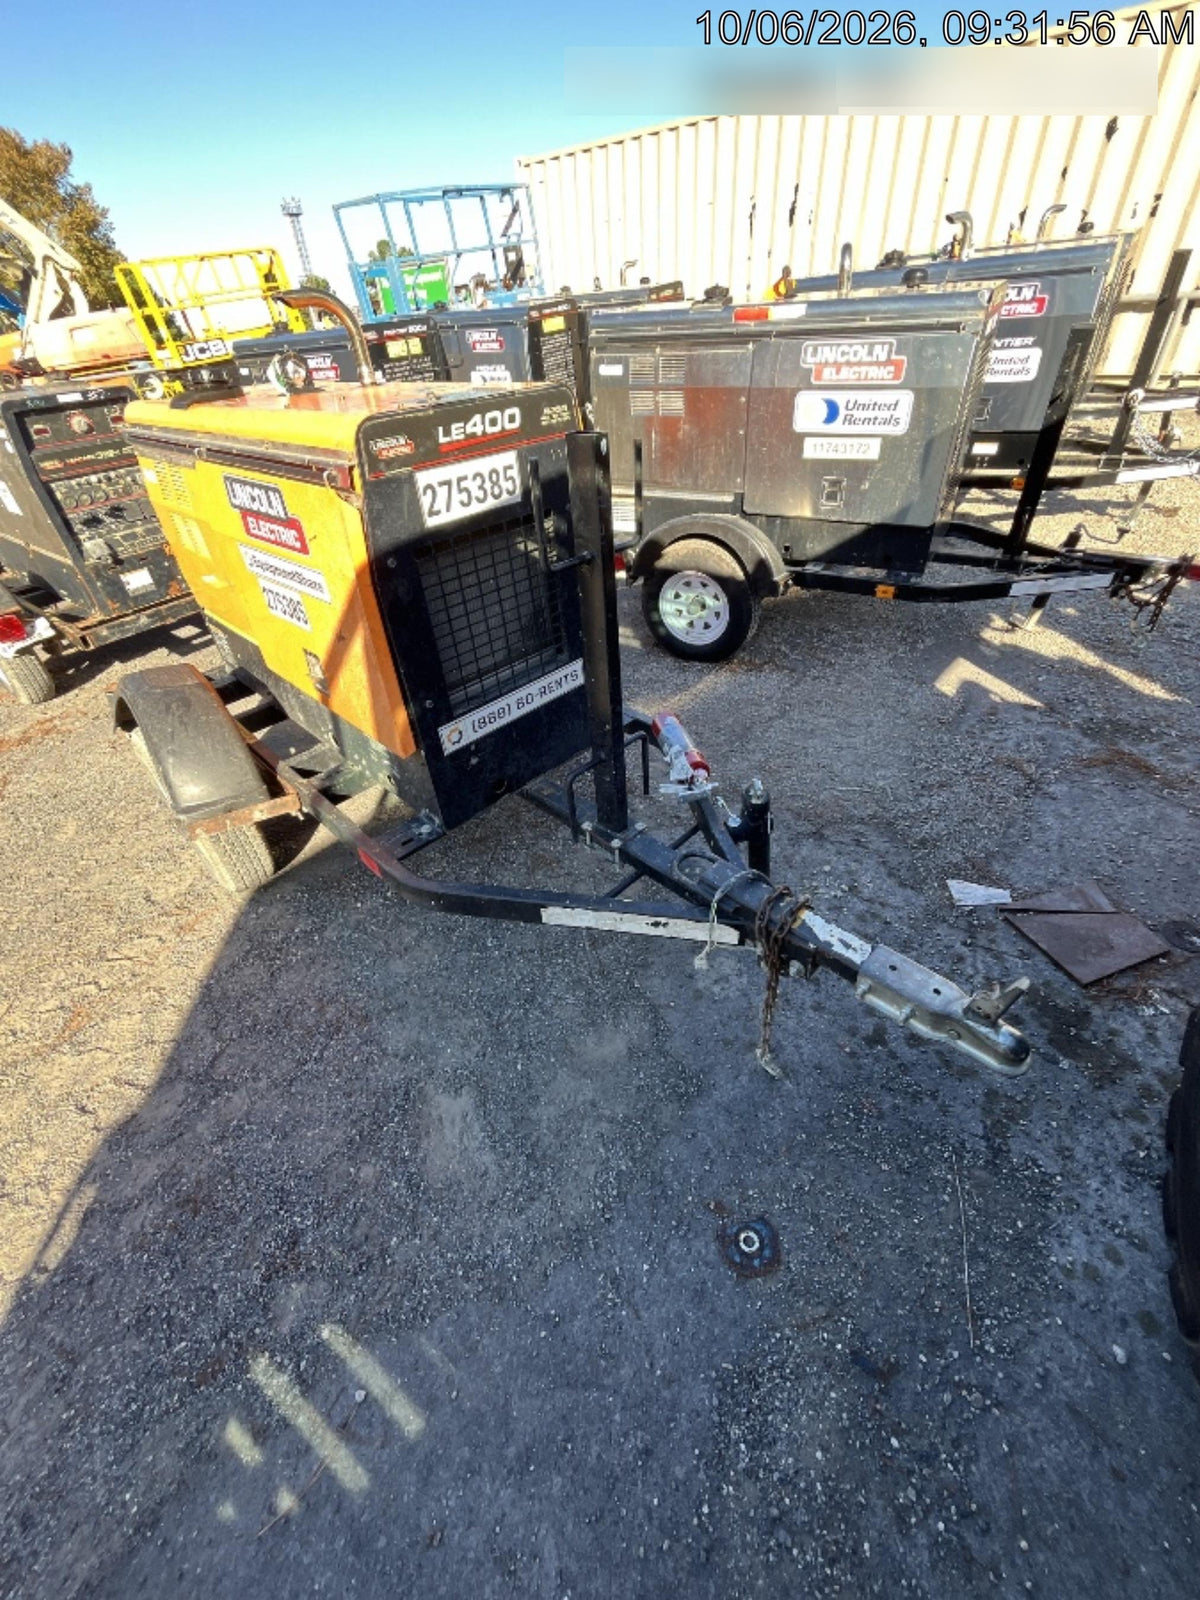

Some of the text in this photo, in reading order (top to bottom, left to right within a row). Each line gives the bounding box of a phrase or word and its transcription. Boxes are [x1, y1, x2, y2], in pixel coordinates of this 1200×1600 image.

[182, 340, 227, 362] JCB
[806, 344, 890, 364] LINCOLN
[821, 365, 895, 380] ELECTRIC
[844, 399, 900, 412] United
[438, 407, 521, 443] LE400
[842, 413, 901, 427] Rentals
[813, 442, 870, 455] 11743172
[227, 479, 287, 519] LINCOLN
[422, 464, 518, 518] 275385
[247, 515, 302, 548] ELECTRIC
